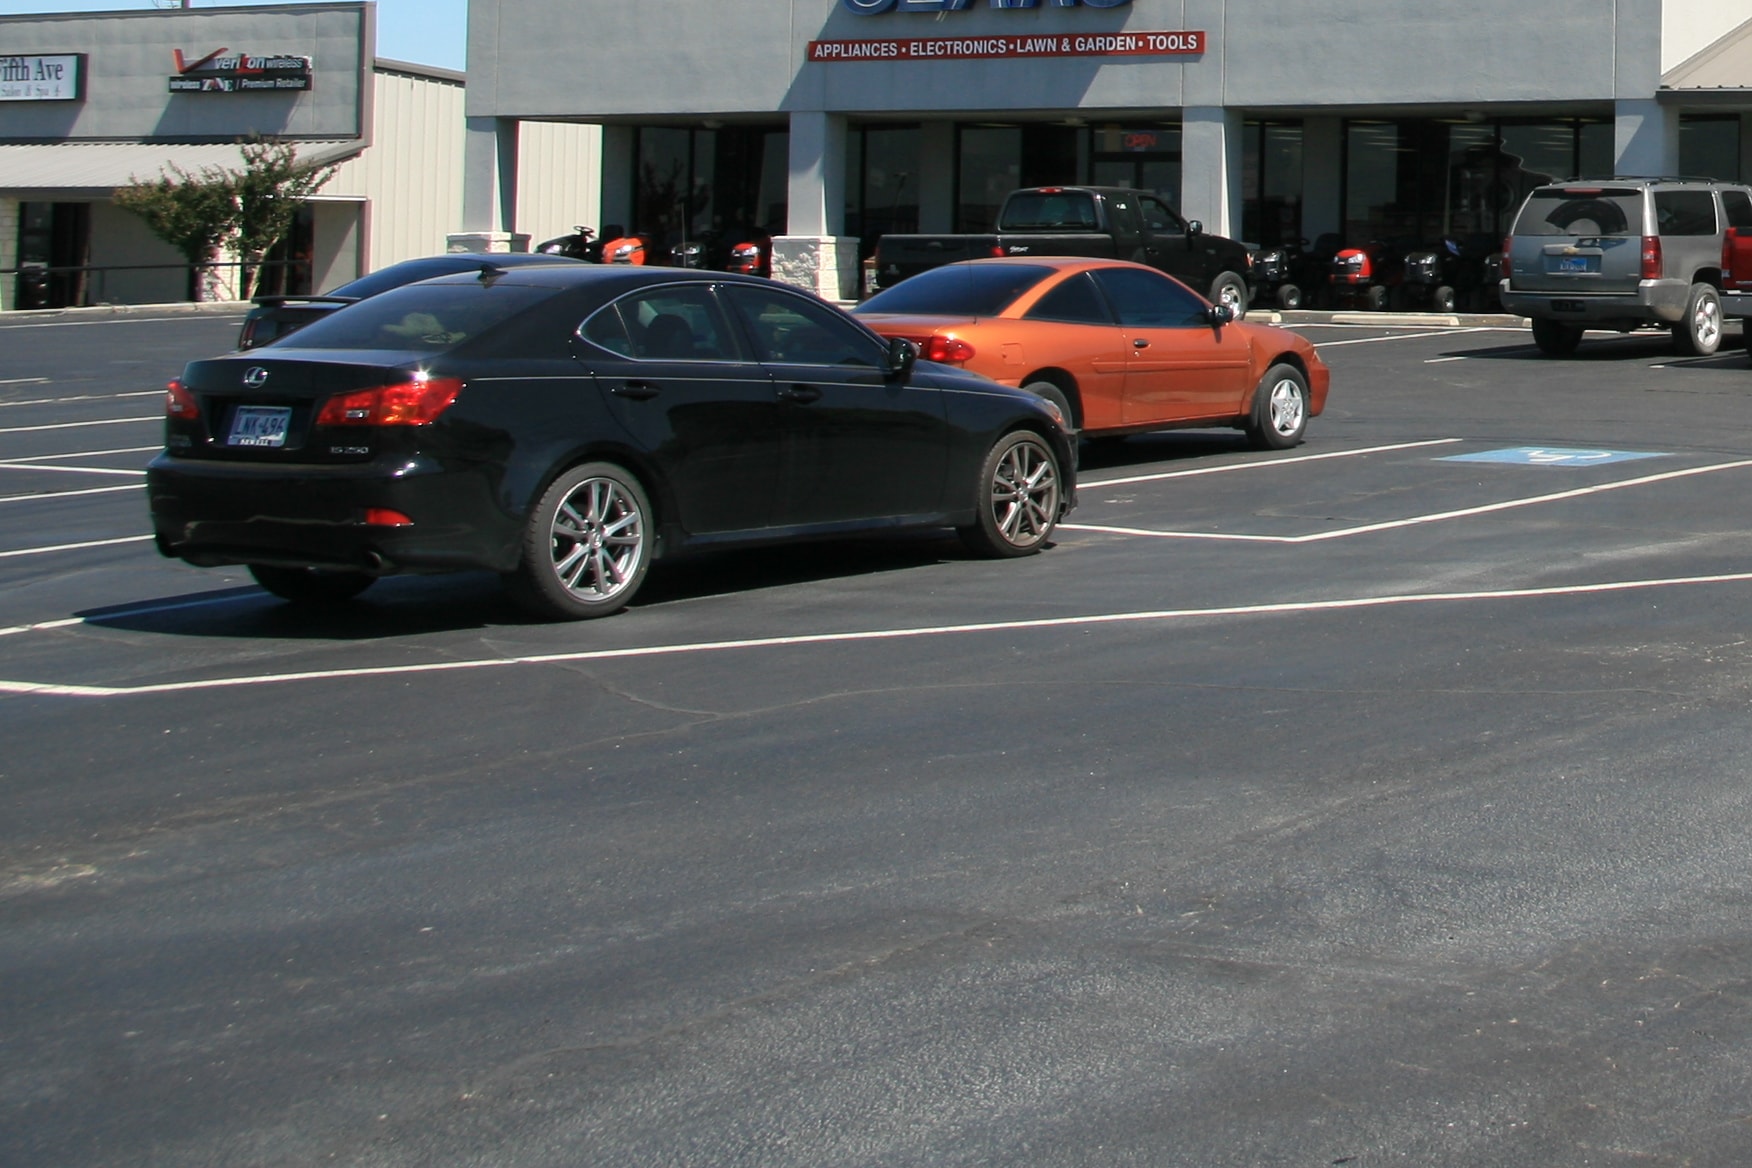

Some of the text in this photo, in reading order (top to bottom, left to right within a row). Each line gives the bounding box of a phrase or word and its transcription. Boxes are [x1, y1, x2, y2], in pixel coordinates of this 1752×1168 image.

[814, 35, 1198, 58] APPLIANCES ELECTRONICS LAWN & GARDEN TOOLS
[34, 58, 64, 81] Ave
[213, 53, 304, 74] verizon wireless
